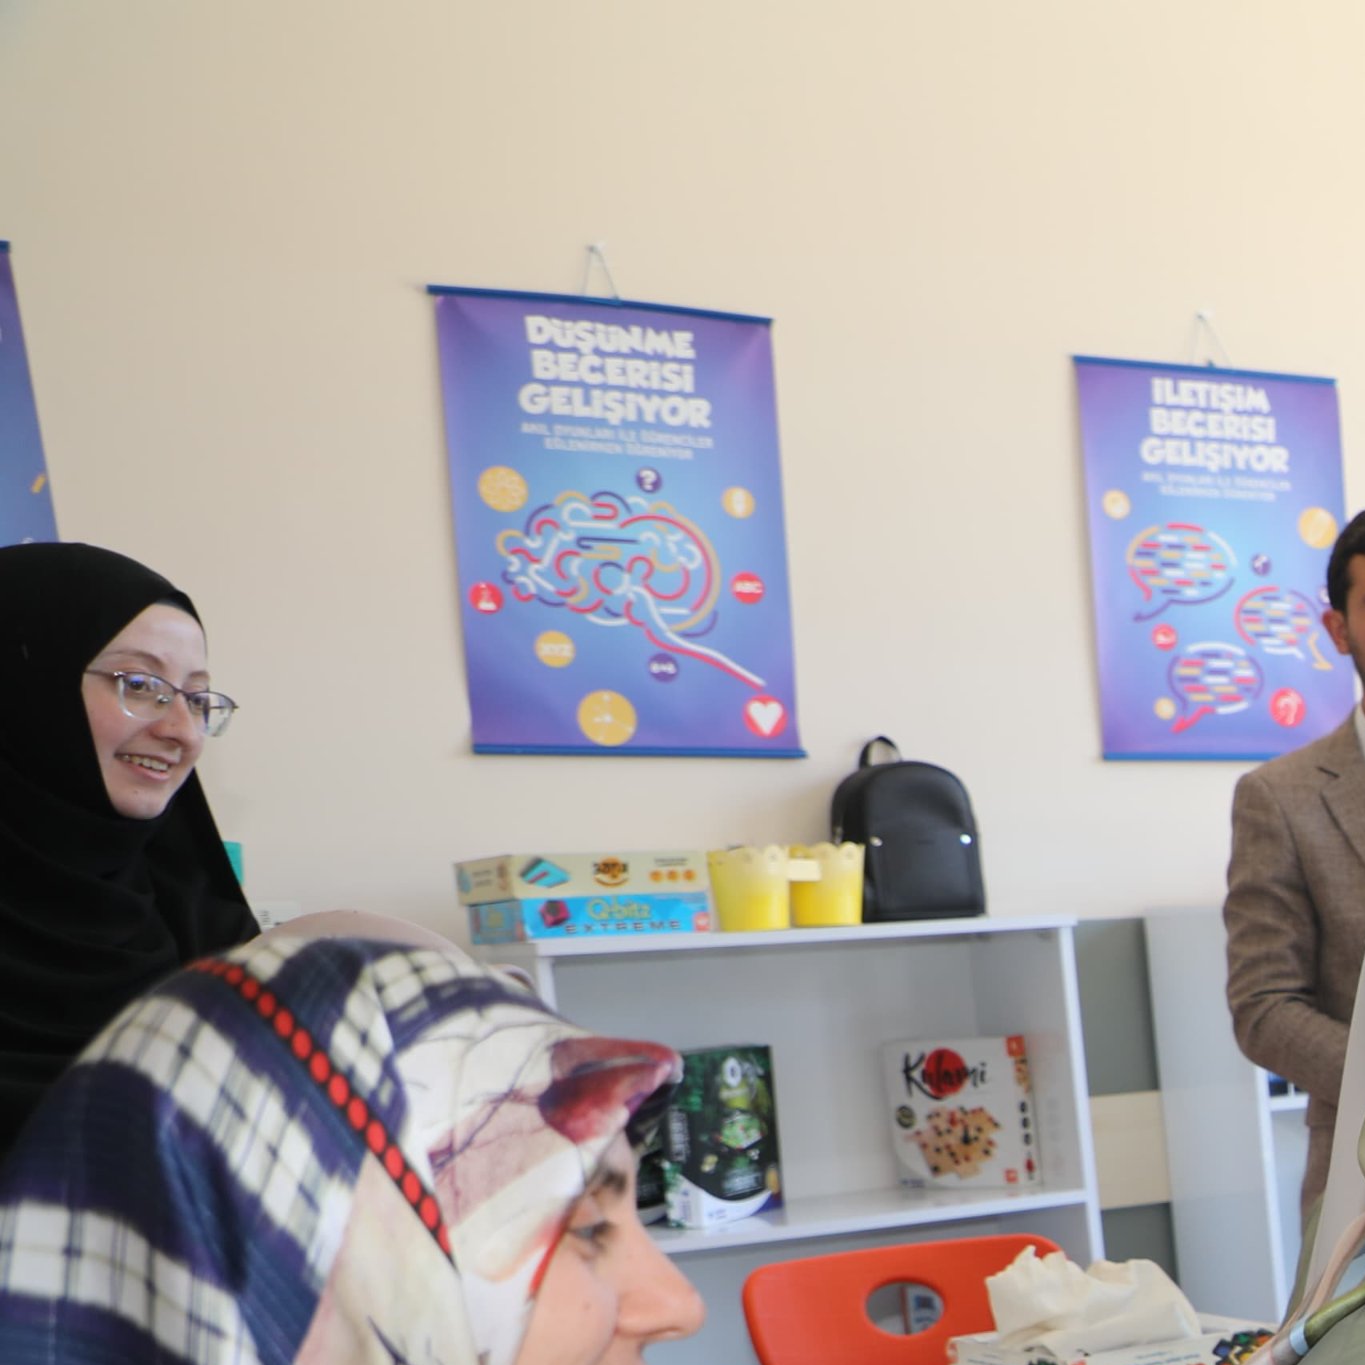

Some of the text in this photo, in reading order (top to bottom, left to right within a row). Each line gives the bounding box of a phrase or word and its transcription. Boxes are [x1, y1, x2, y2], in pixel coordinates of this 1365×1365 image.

[523, 314, 696, 359] DÜŞÜNME
[518, 382, 712, 428] GELİŞİYOR
[565, 920, 681, 934] EXTREME
